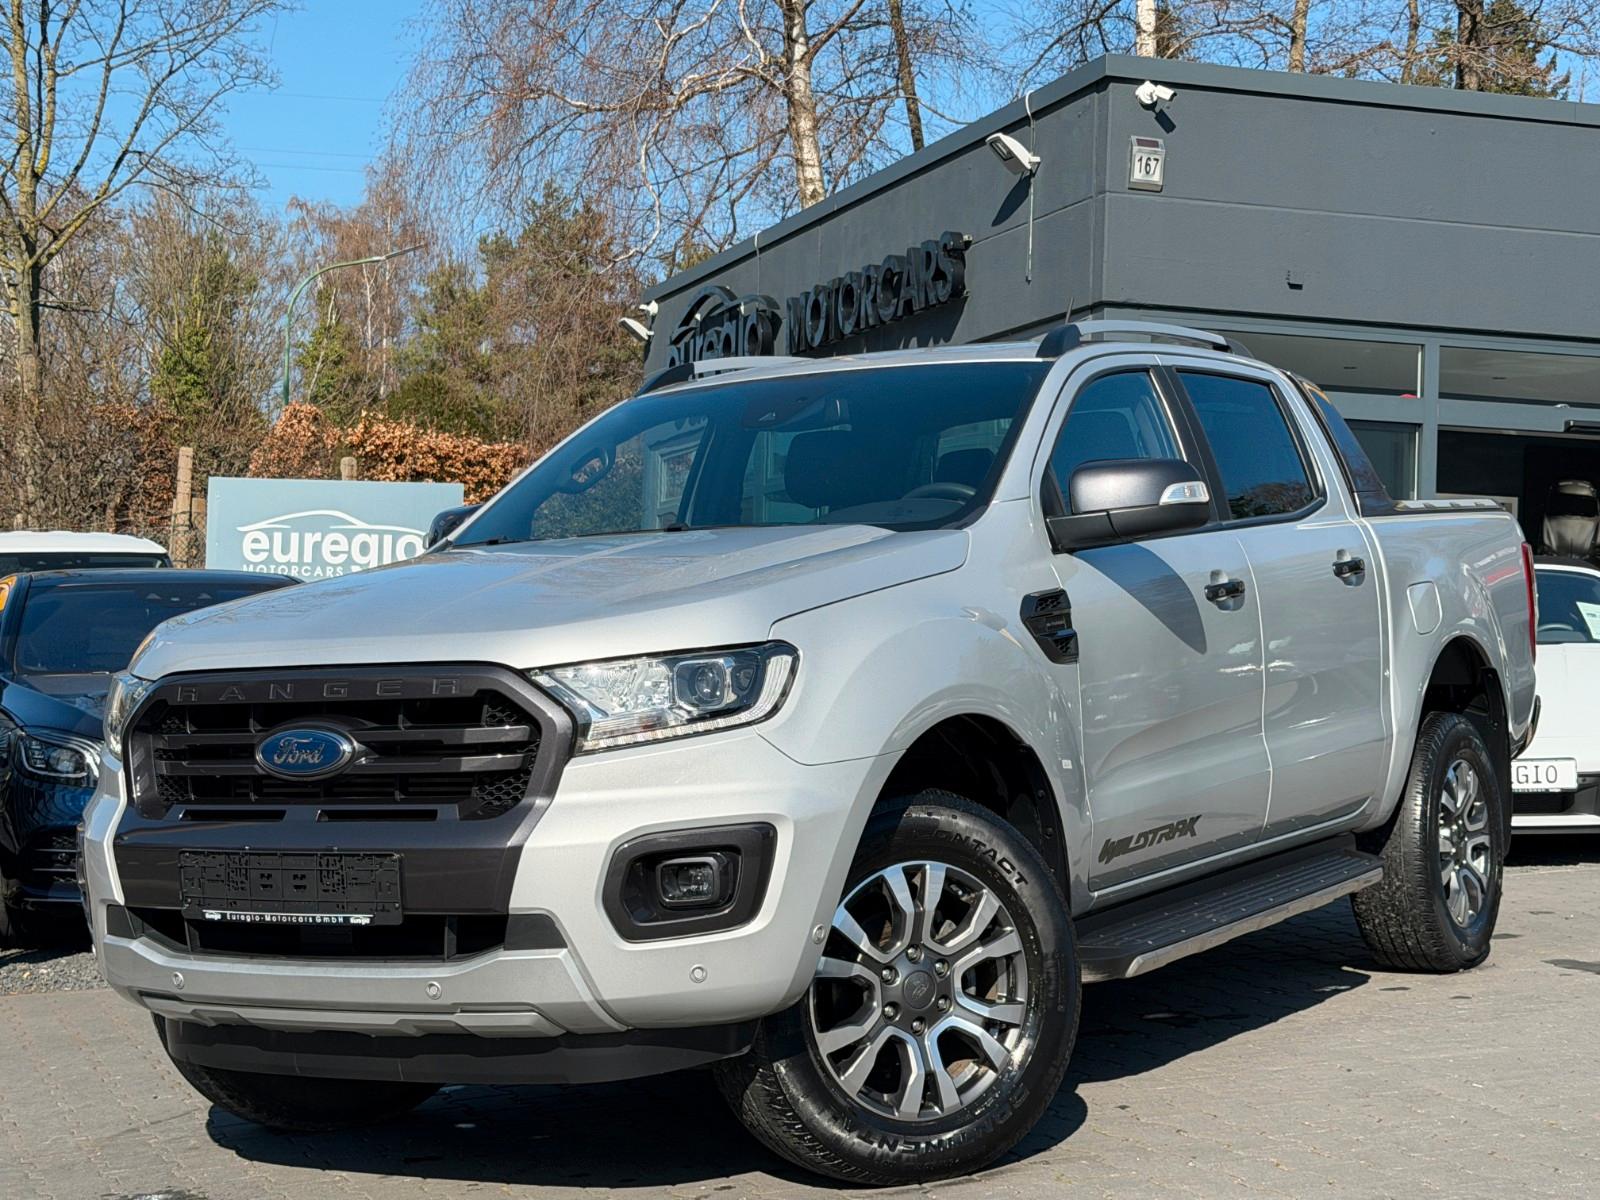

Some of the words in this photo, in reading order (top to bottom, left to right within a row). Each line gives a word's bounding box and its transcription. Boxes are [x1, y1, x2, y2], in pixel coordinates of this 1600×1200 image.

[1137, 155, 1160, 176] 167
[786, 231, 966, 352] MOTORCARS
[242, 564, 344, 577] MOTORCARS
[177, 678, 460, 703] RANGER
[273, 737, 324, 764] Ford
[1511, 765, 1558, 784] GIO
[1098, 814, 1202, 865] WILDTRAK
